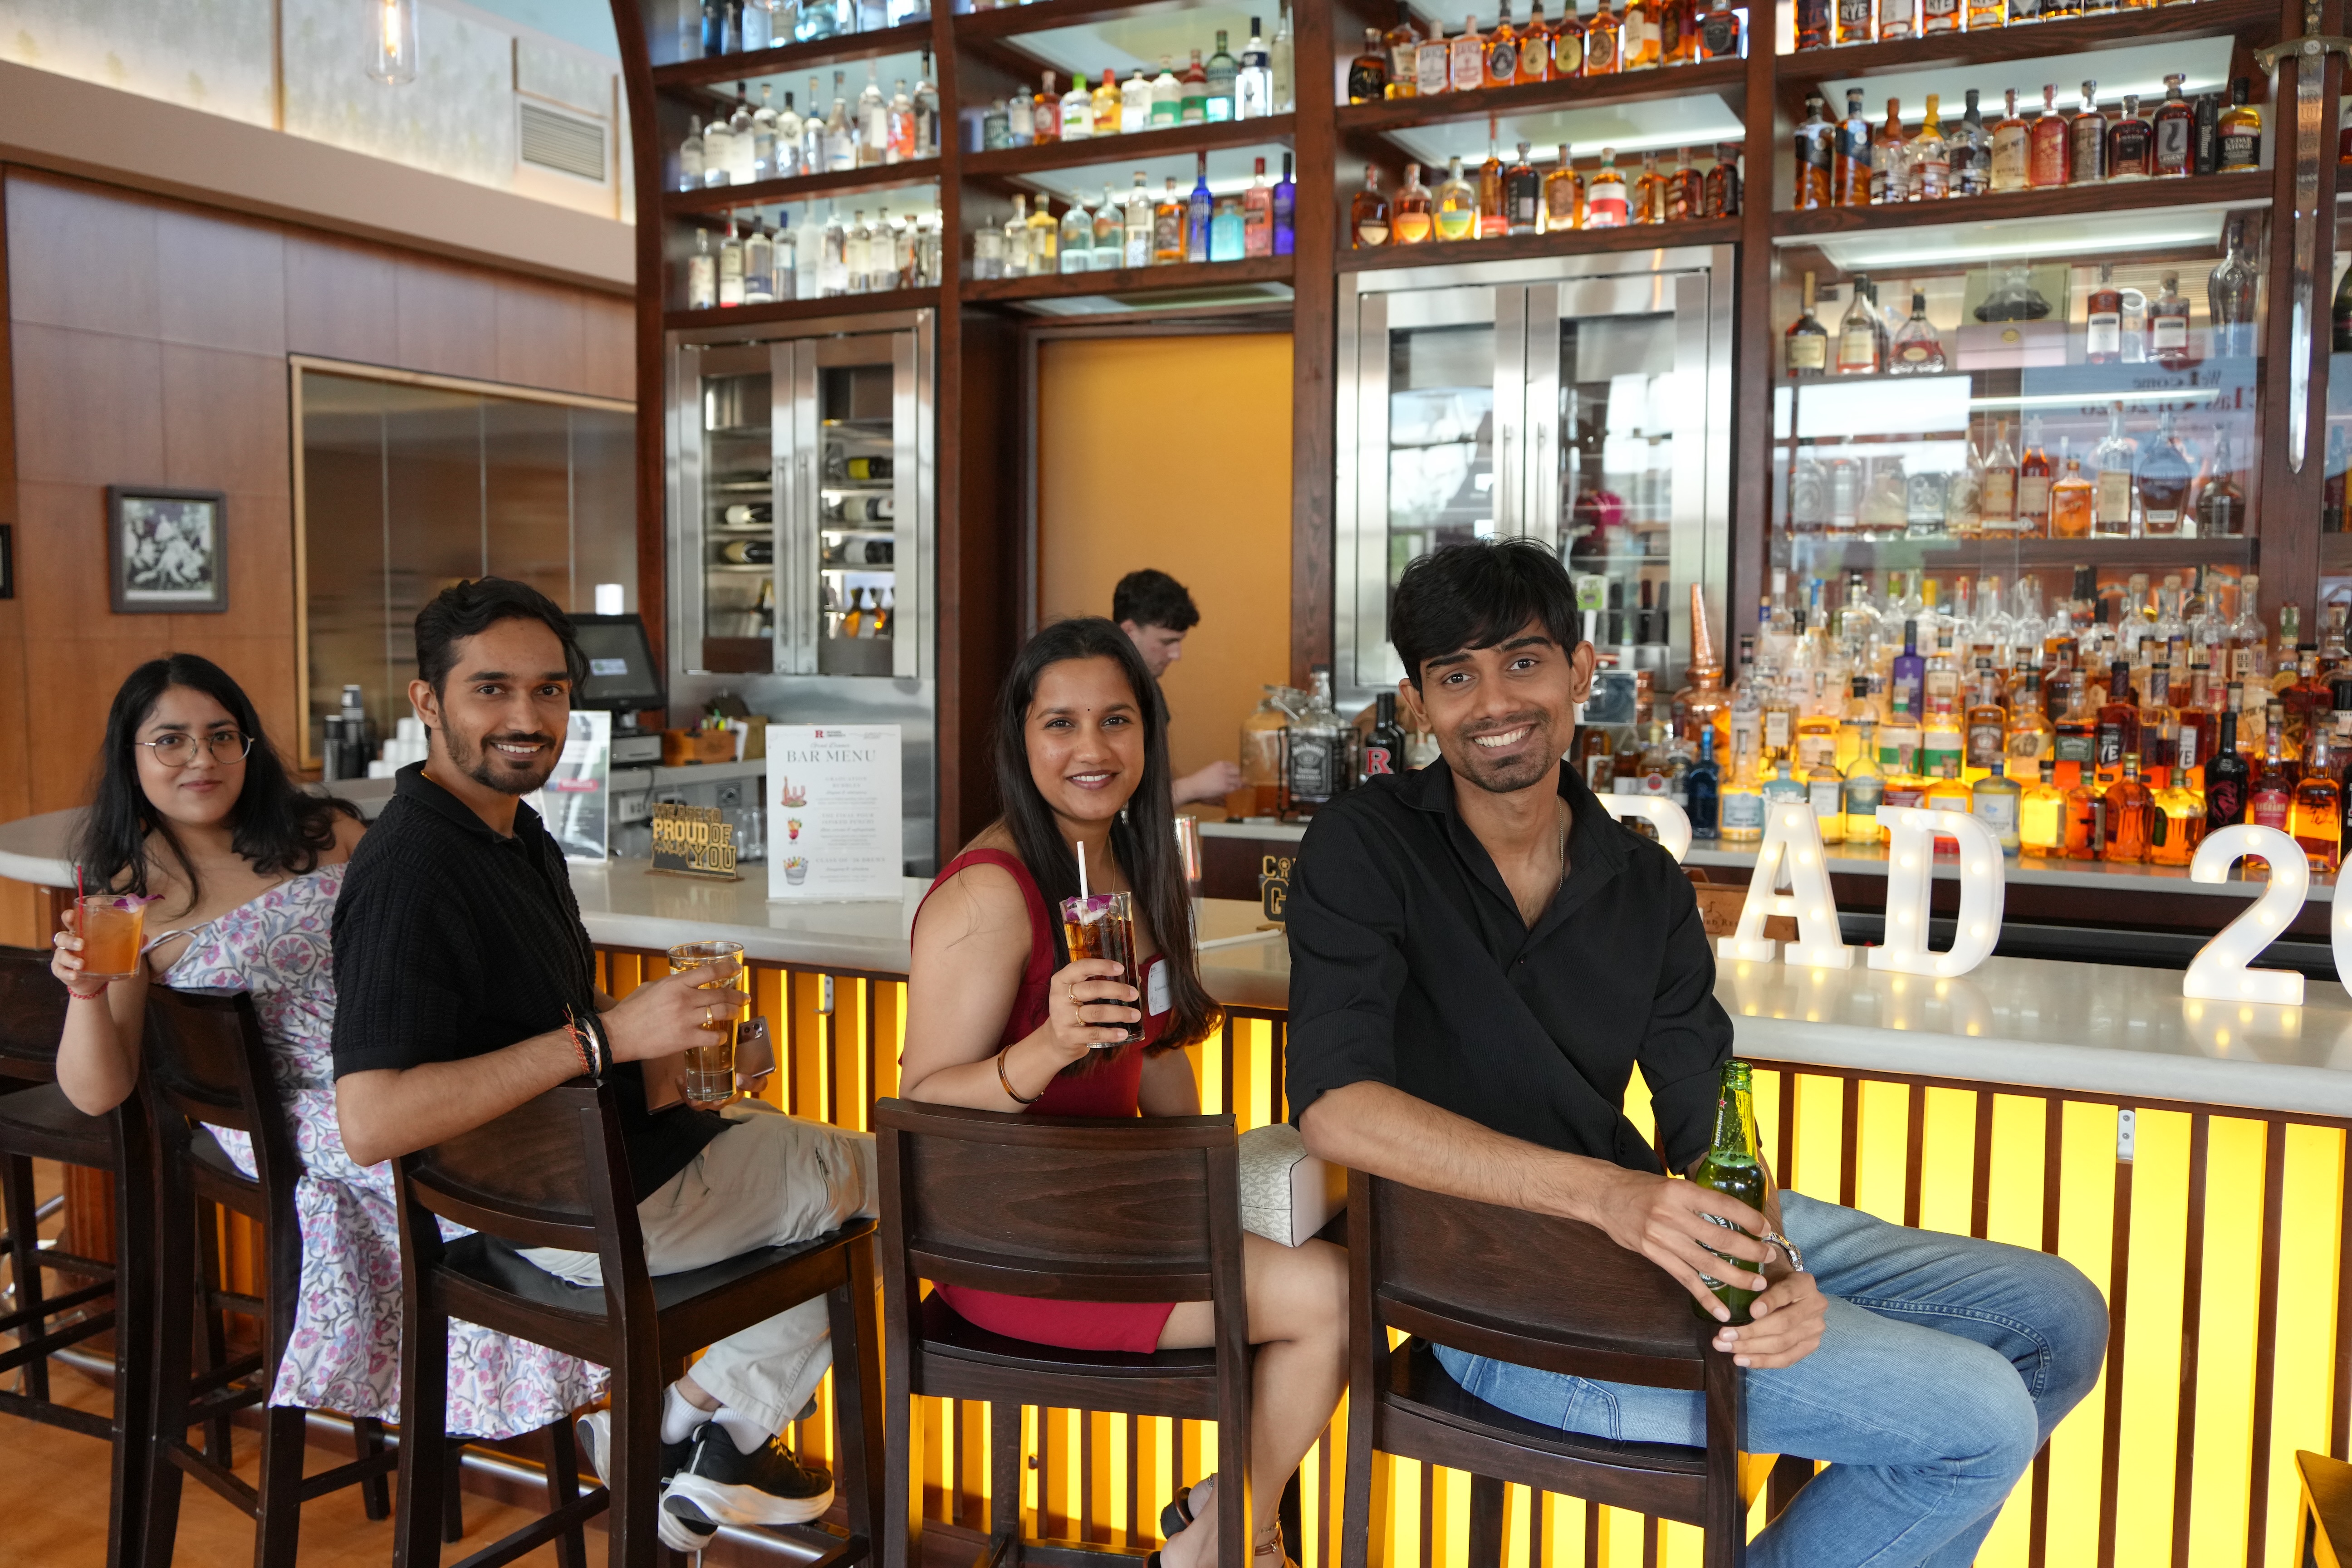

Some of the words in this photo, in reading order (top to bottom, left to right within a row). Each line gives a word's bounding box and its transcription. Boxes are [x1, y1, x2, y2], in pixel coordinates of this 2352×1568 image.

[1840, 3, 1868, 20] RYE
[787, 750, 820, 763] BAR
[826, 750, 876, 763] MENU
[1366, 746, 1395, 774] R
[652, 803, 676, 820] WE
[652, 818, 709, 844] PROUD
[709, 823, 734, 845] OF
[689, 843, 737, 872] YOU
[1714, 1108, 1724, 1147] Heineken
